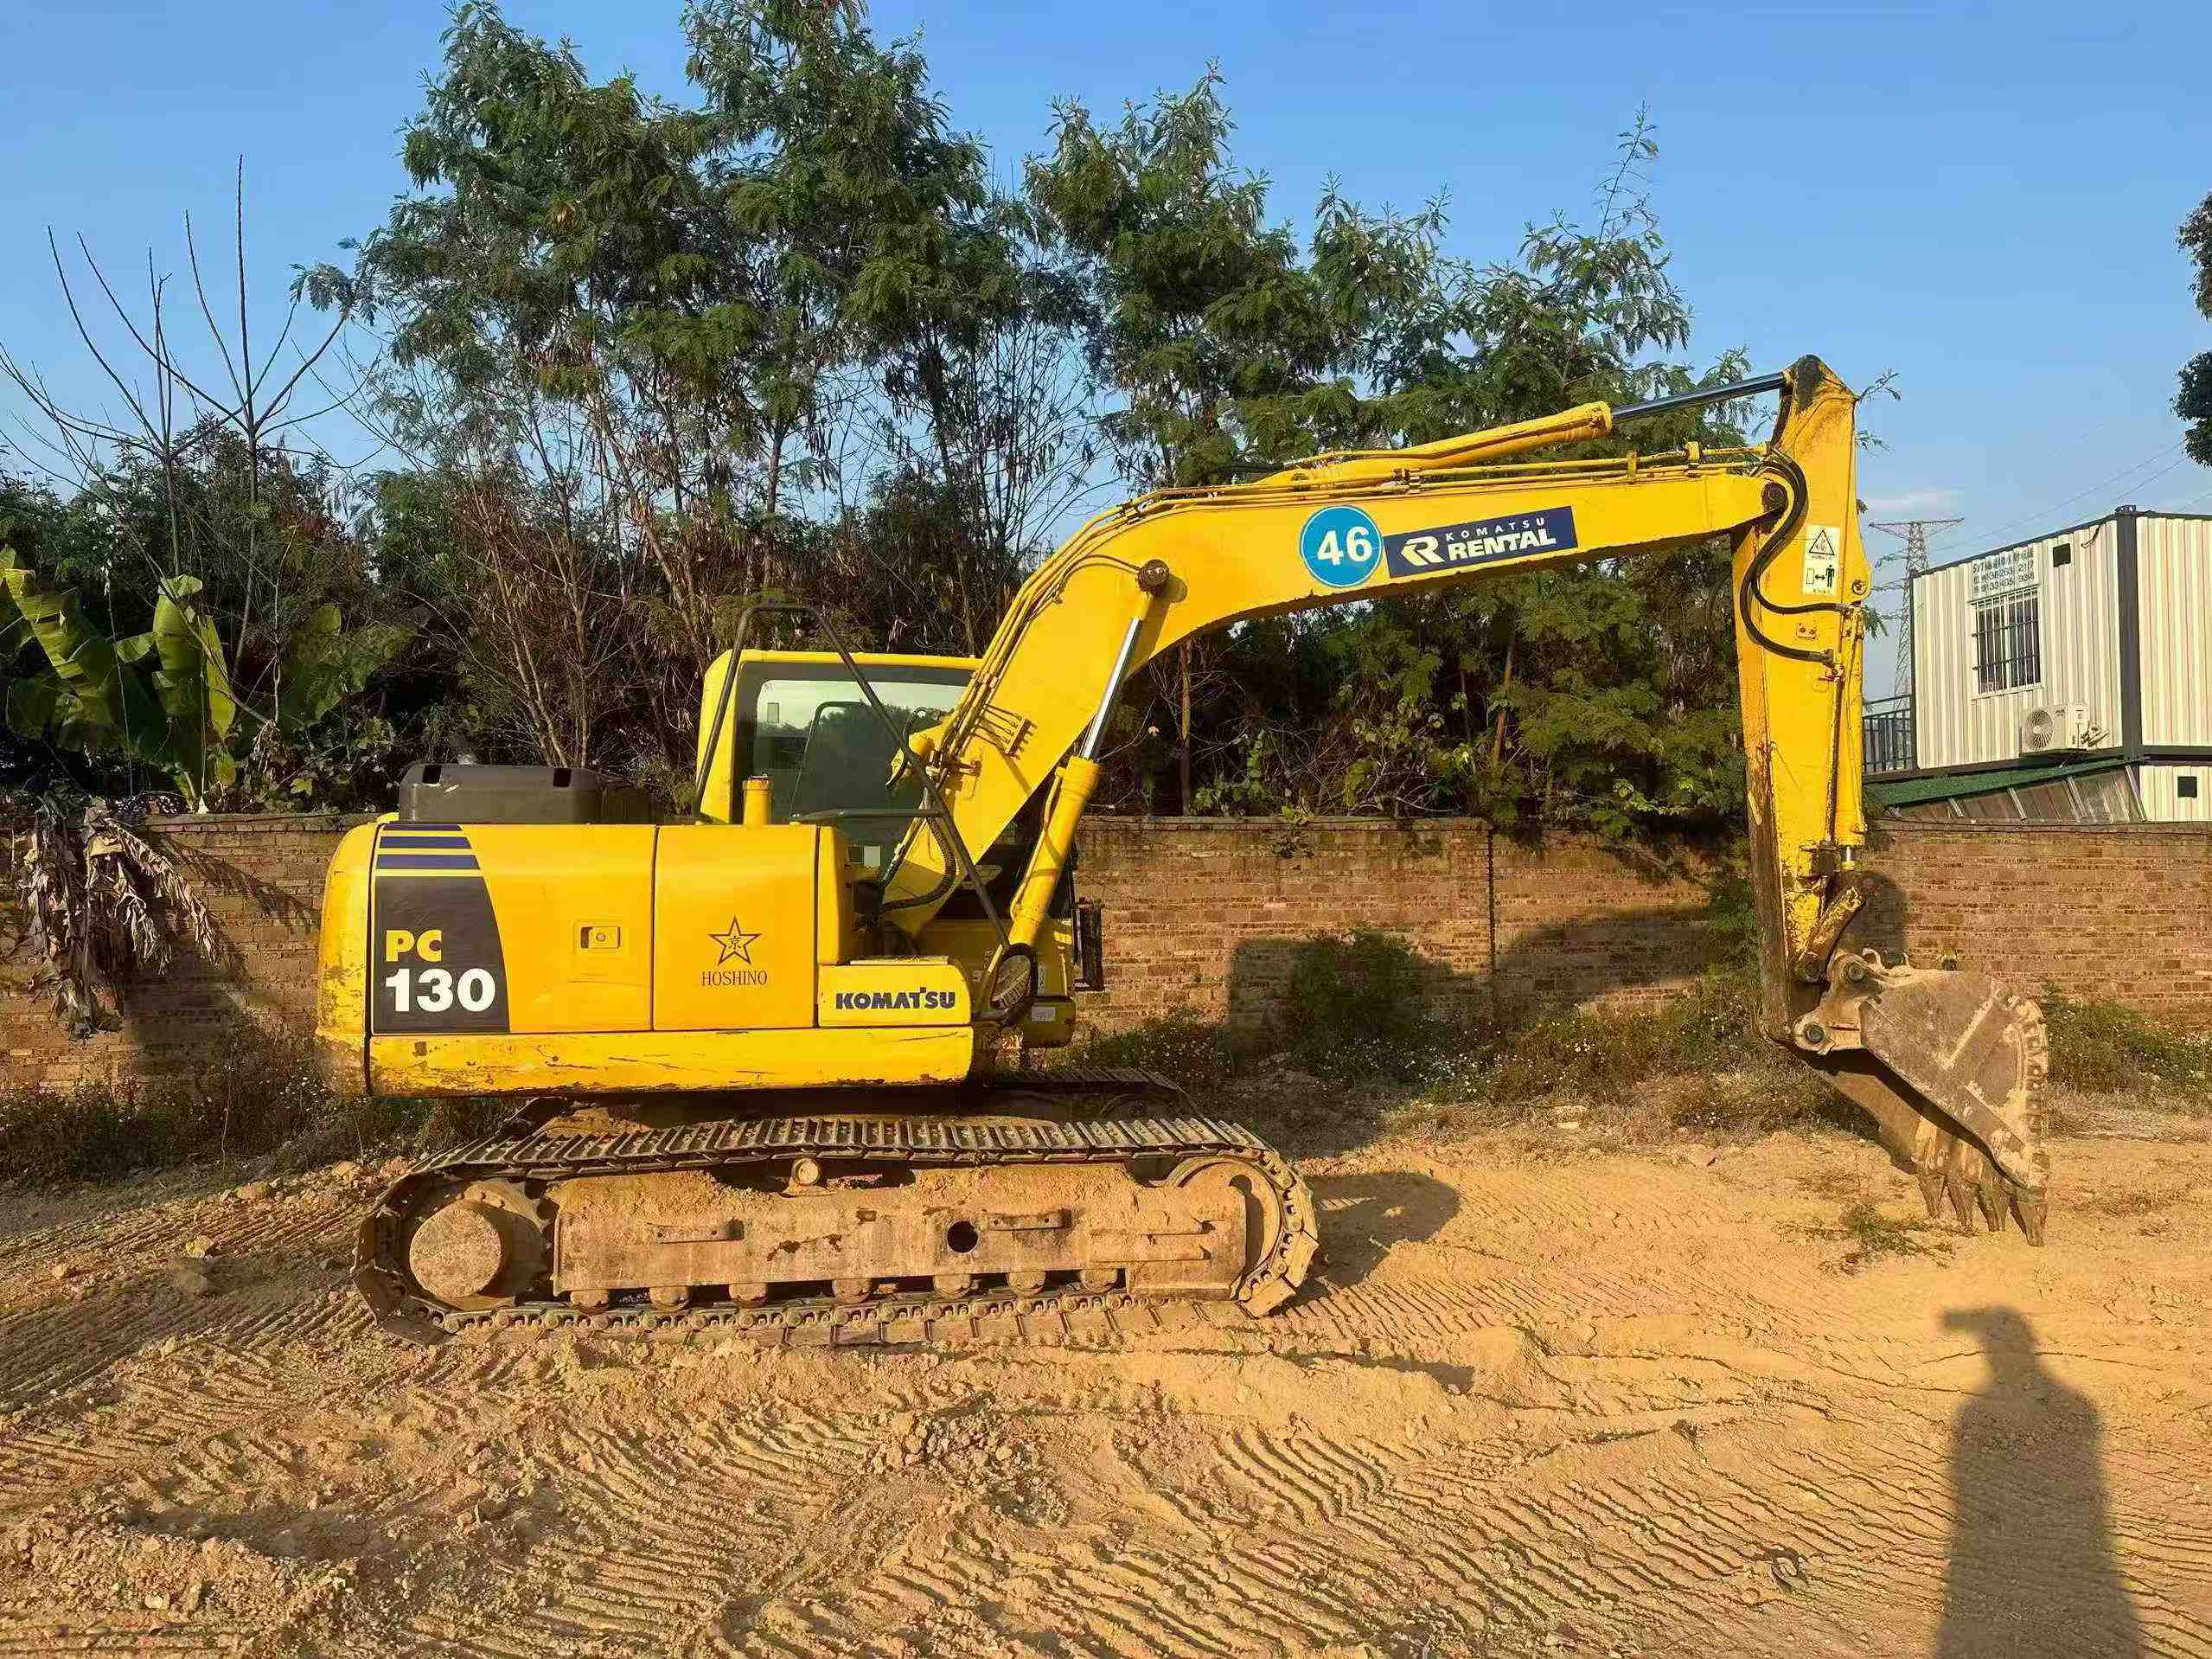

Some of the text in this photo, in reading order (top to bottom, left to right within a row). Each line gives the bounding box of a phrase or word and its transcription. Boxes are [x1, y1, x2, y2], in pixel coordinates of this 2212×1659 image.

[1445, 517, 1544, 541] KOMATSU
[1447, 528, 1557, 560] RENTAL
[1316, 526, 1372, 566] 46
[386, 930, 442, 962] PC
[386, 968, 496, 1012] 130
[701, 970, 768, 986] HOSHINO
[835, 987, 956, 1009] KOMATSU
